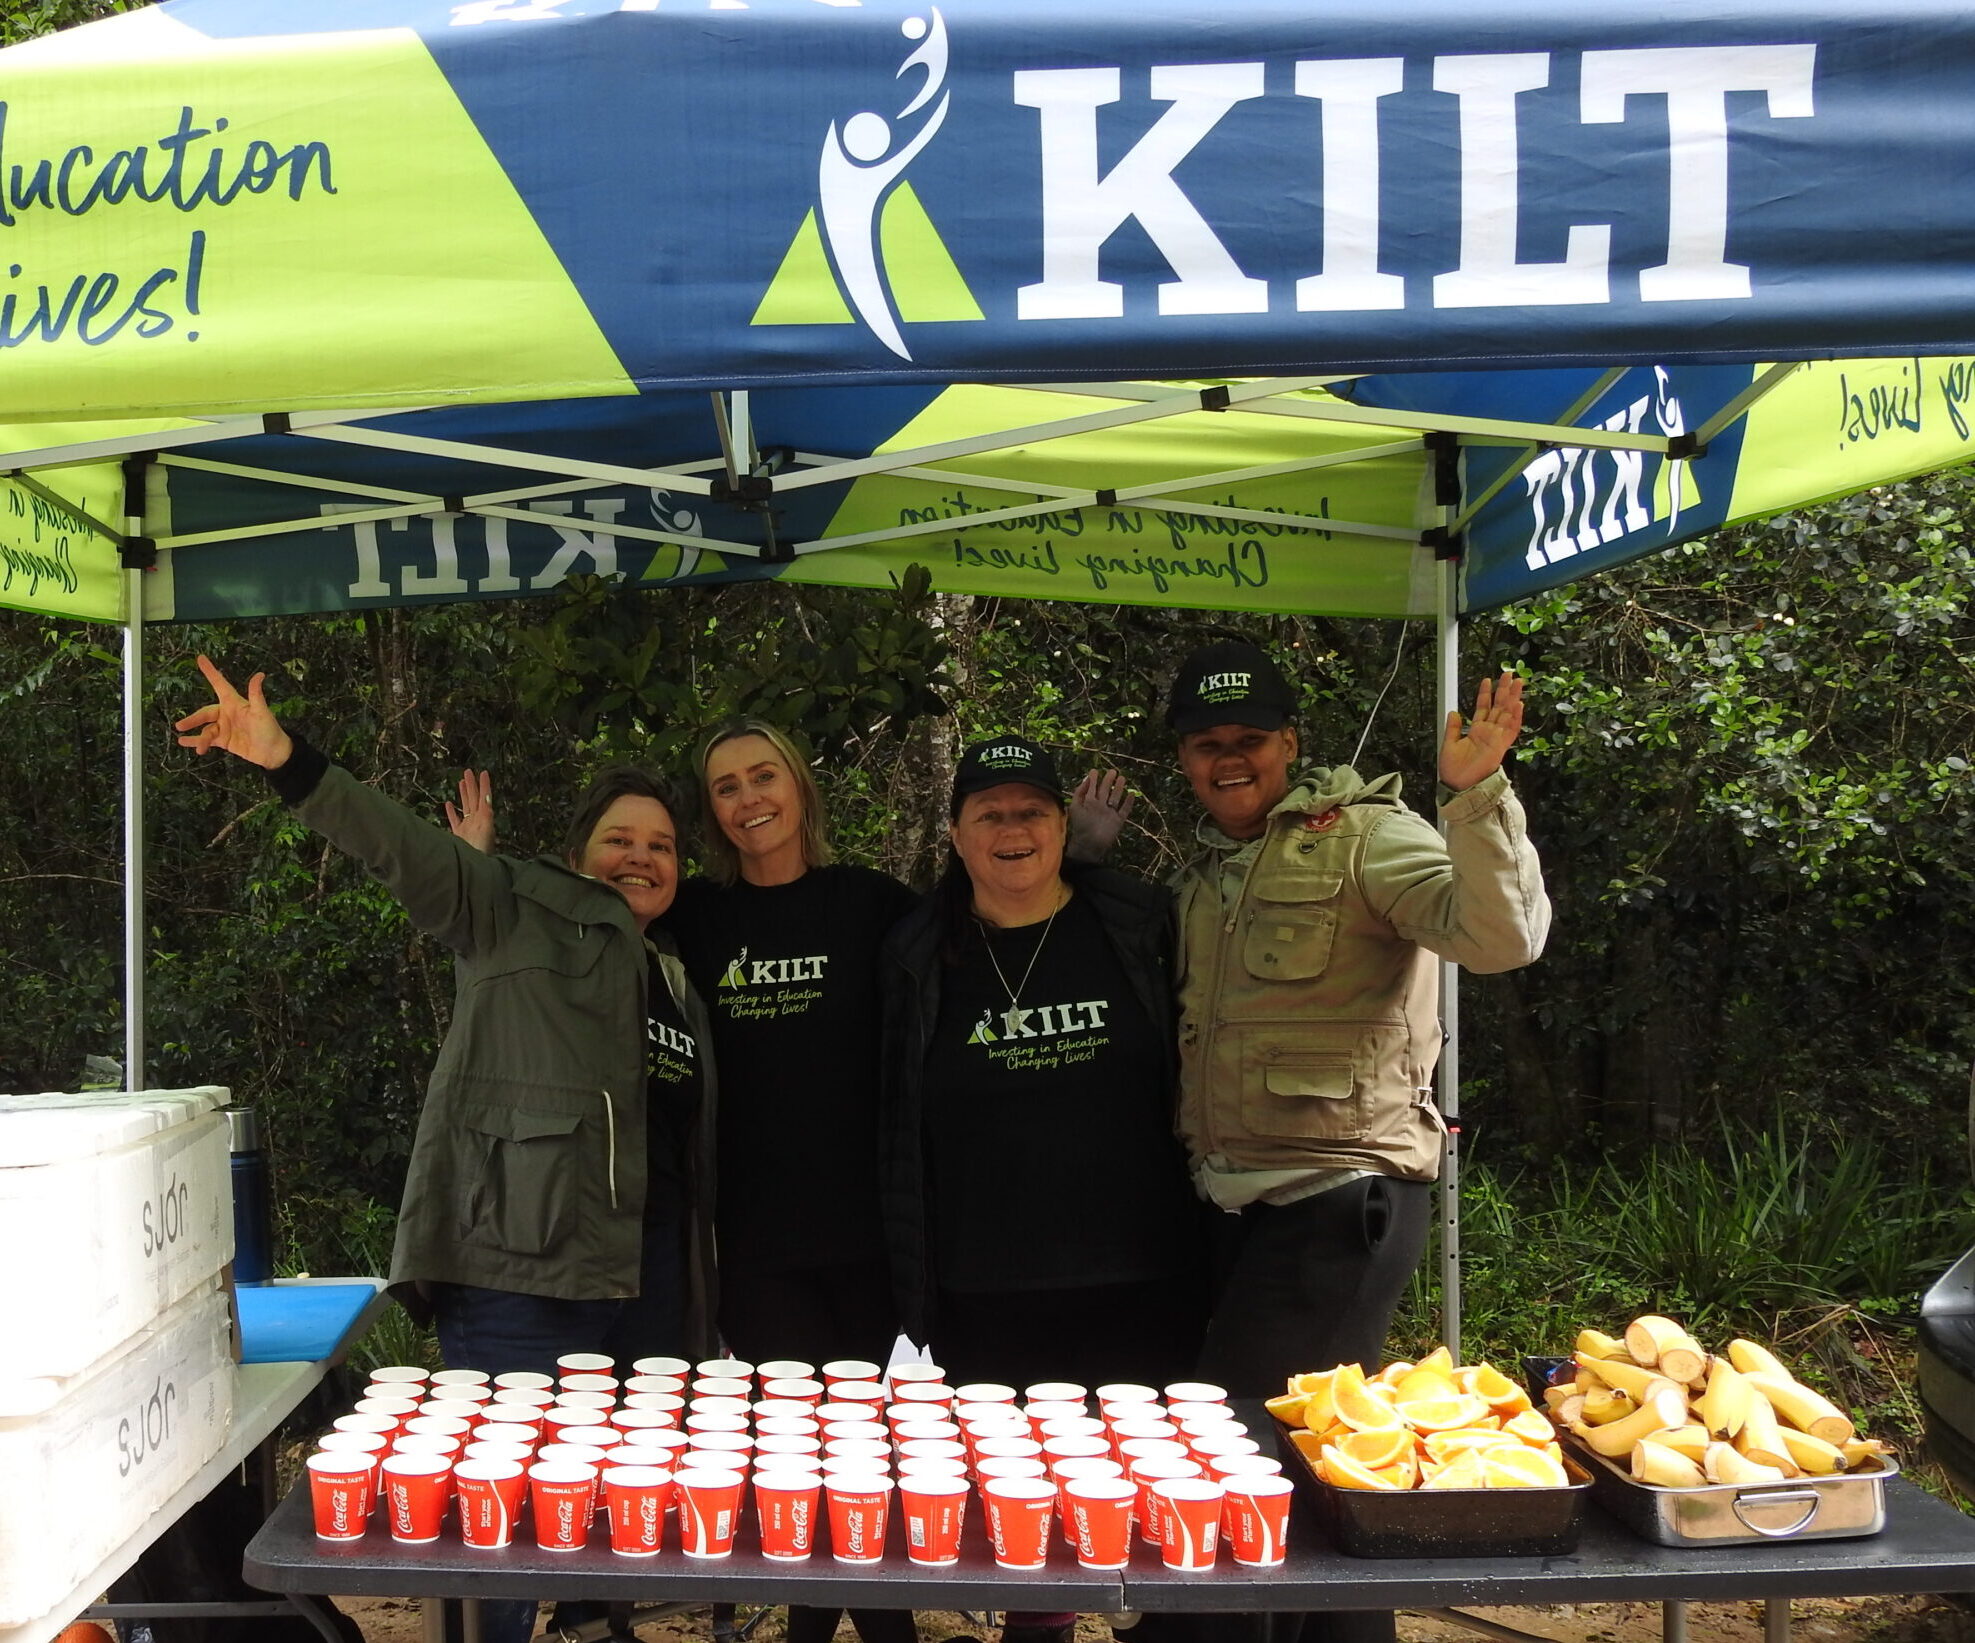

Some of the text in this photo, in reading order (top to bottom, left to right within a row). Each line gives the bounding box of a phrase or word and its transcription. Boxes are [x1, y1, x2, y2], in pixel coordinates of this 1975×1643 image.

[1013, 43, 1817, 320] KILT
[0, 230, 206, 348] ives!
[1208, 673, 1251, 691] KILT
[991, 745, 1033, 761] KILT
[751, 955, 828, 984] KILT
[718, 988, 822, 1007] Investing in Education
[730, 1000, 809, 1020] Changing Lives!
[1000, 1000, 1109, 1041] KILT
[988, 1036, 1110, 1060] Investing in Education
[1006, 1047, 1095, 1070] Changing Lives!
[862, 1496, 881, 1505] TASTE
